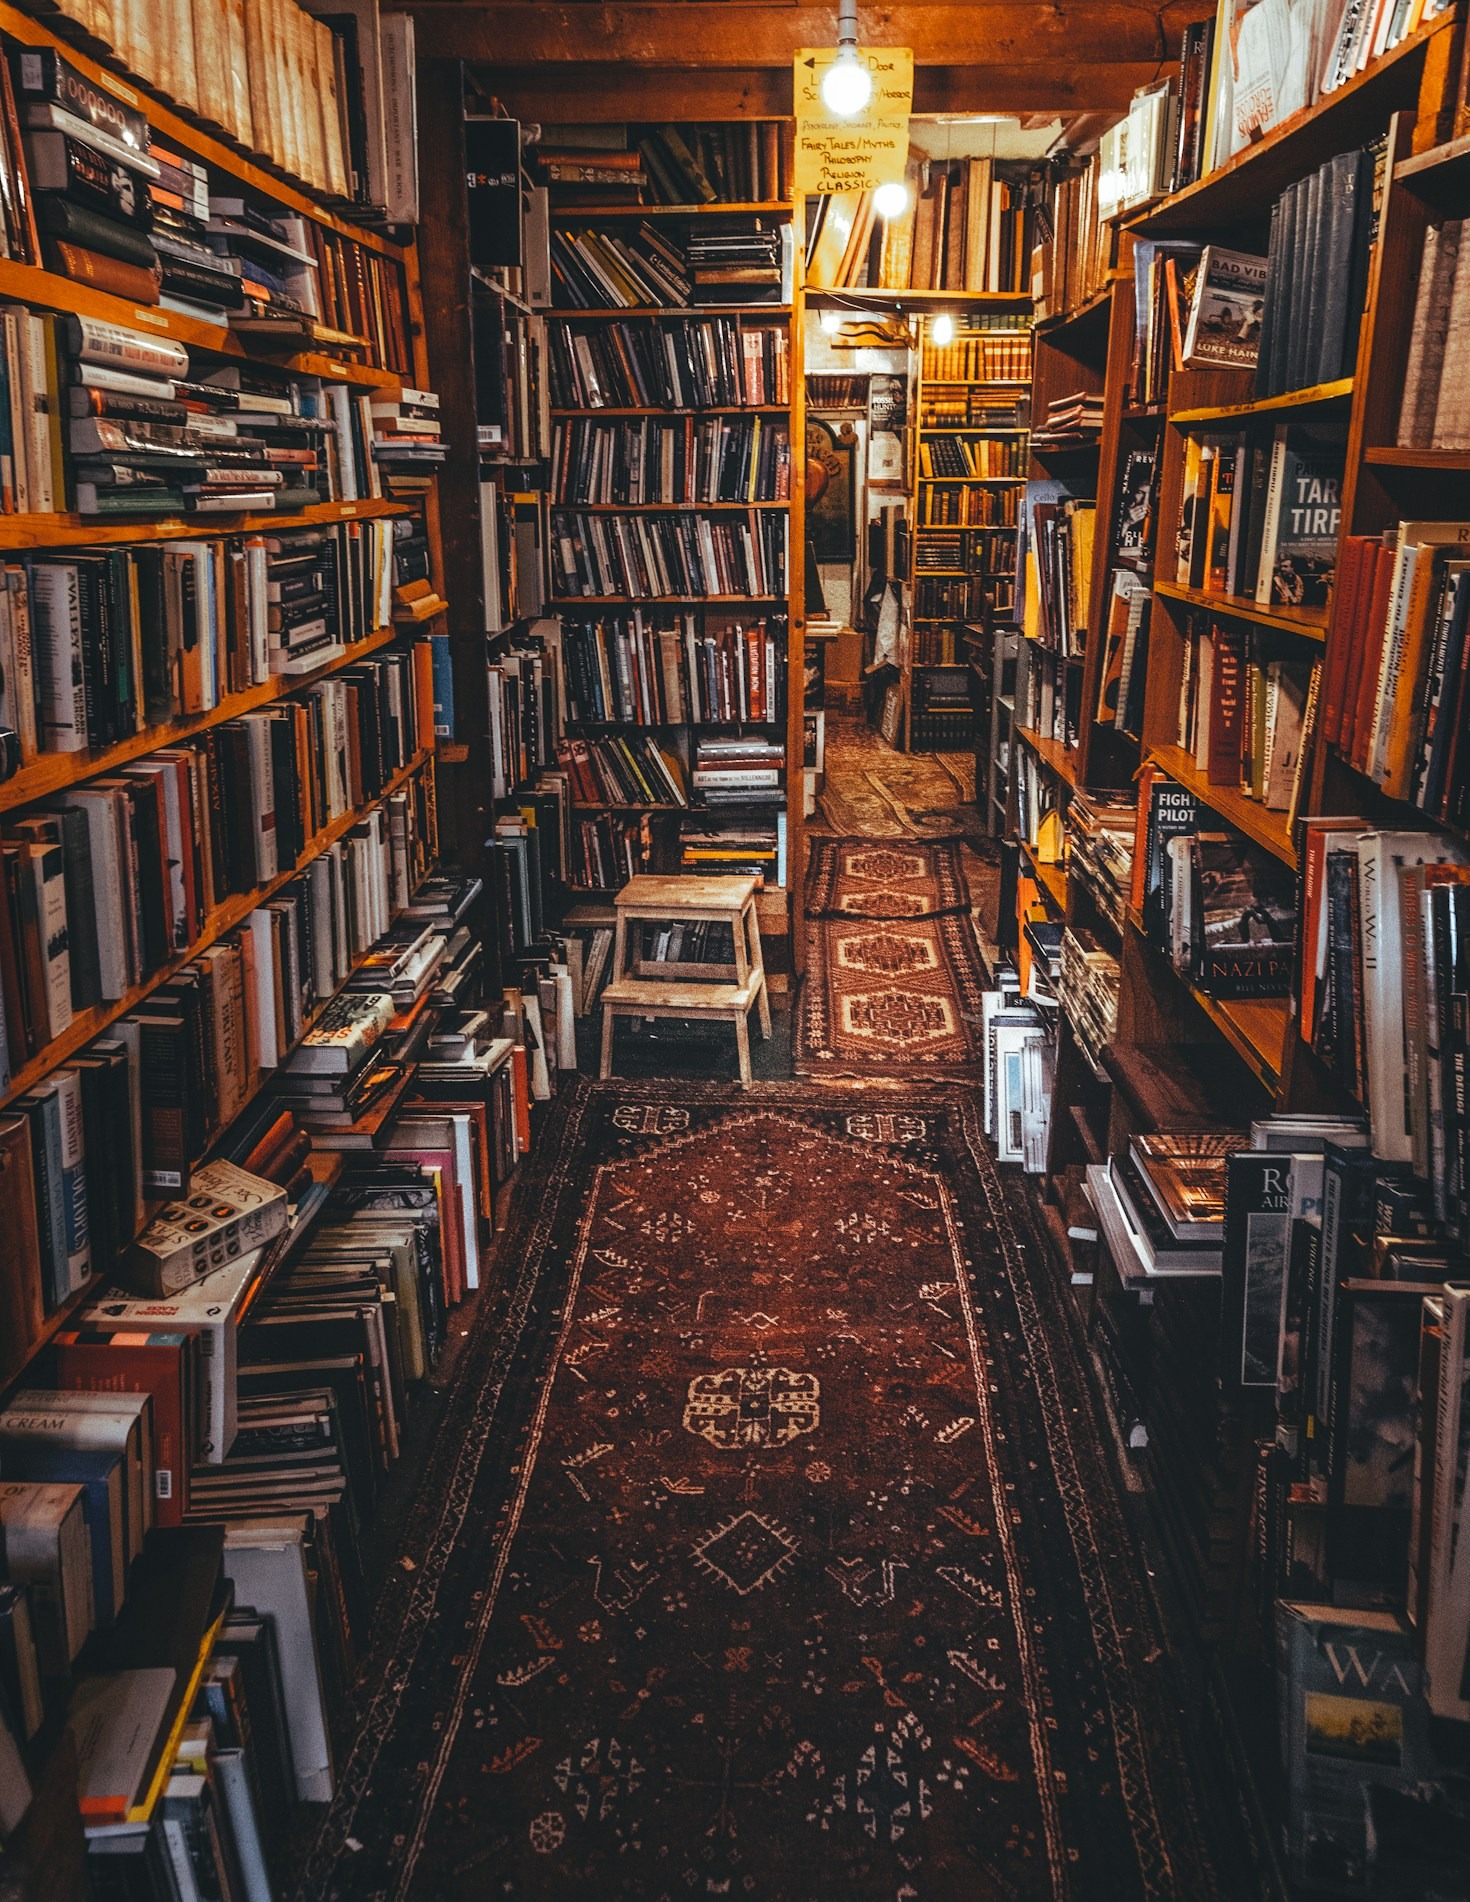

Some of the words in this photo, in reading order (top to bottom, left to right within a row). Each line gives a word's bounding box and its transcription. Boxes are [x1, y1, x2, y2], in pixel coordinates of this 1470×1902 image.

[801, 137, 827, 151] FAIRY
[820, 151, 873, 165] PHILOSOPHY
[820, 167, 866, 179] RELIGION
[1211, 259, 1241, 272] BAD
[1243, 266, 1268, 280] VIB
[1197, 343, 1225, 354] LUKE
[1228, 347, 1259, 359] HAIN
[873, 403, 895, 411] HUNT
[1033, 493, 1055, 502] Cello
[1296, 478, 1338, 504] TAR
[1291, 508, 1342, 535] TIRP
[1397, 556, 1410, 601] Einsatz
[68, 581, 80, 649] VALLEY
[1394, 603, 1403, 622] für
[1384, 624, 1399, 697] Psychologie
[1393, 629, 1406, 672] Notfall
[1390, 674, 1400, 698] und
[211, 785, 220, 811] XIV
[1157, 808, 1196, 824] PILOT
[1306, 863, 1314, 898] MEADOW
[1404, 876, 1417, 926] WITNESS
[1407, 931, 1417, 946] TO
[1211, 961, 1263, 978] NAZI
[1268, 960, 1291, 976] PA
[1366, 956, 1377, 970] II
[1407, 950, 1418, 990] WORLD
[221, 1004, 234, 1076] BRITAIN
[312, 1026, 353, 1040] SEC
[1454, 1052, 1464, 1071] THE
[1455, 1074, 1465, 1115] DELUGE
[65, 1091, 78, 1158] FREEMANTLE
[1327, 1178, 1335, 1200] THE
[71, 1175, 88, 1250] OCTOPUS
[149, 1220, 189, 1246] STAR
[1325, 1201, 1335, 1254] COMPLETE
[1307, 1234, 1318, 1294] EVIDENCE
[1443, 1303, 1453, 1326] The
[1440, 1332, 1452, 1397] Pictorial
[5, 1417, 67, 1431] CREAM
[1257, 1463, 1268, 1512] KING
